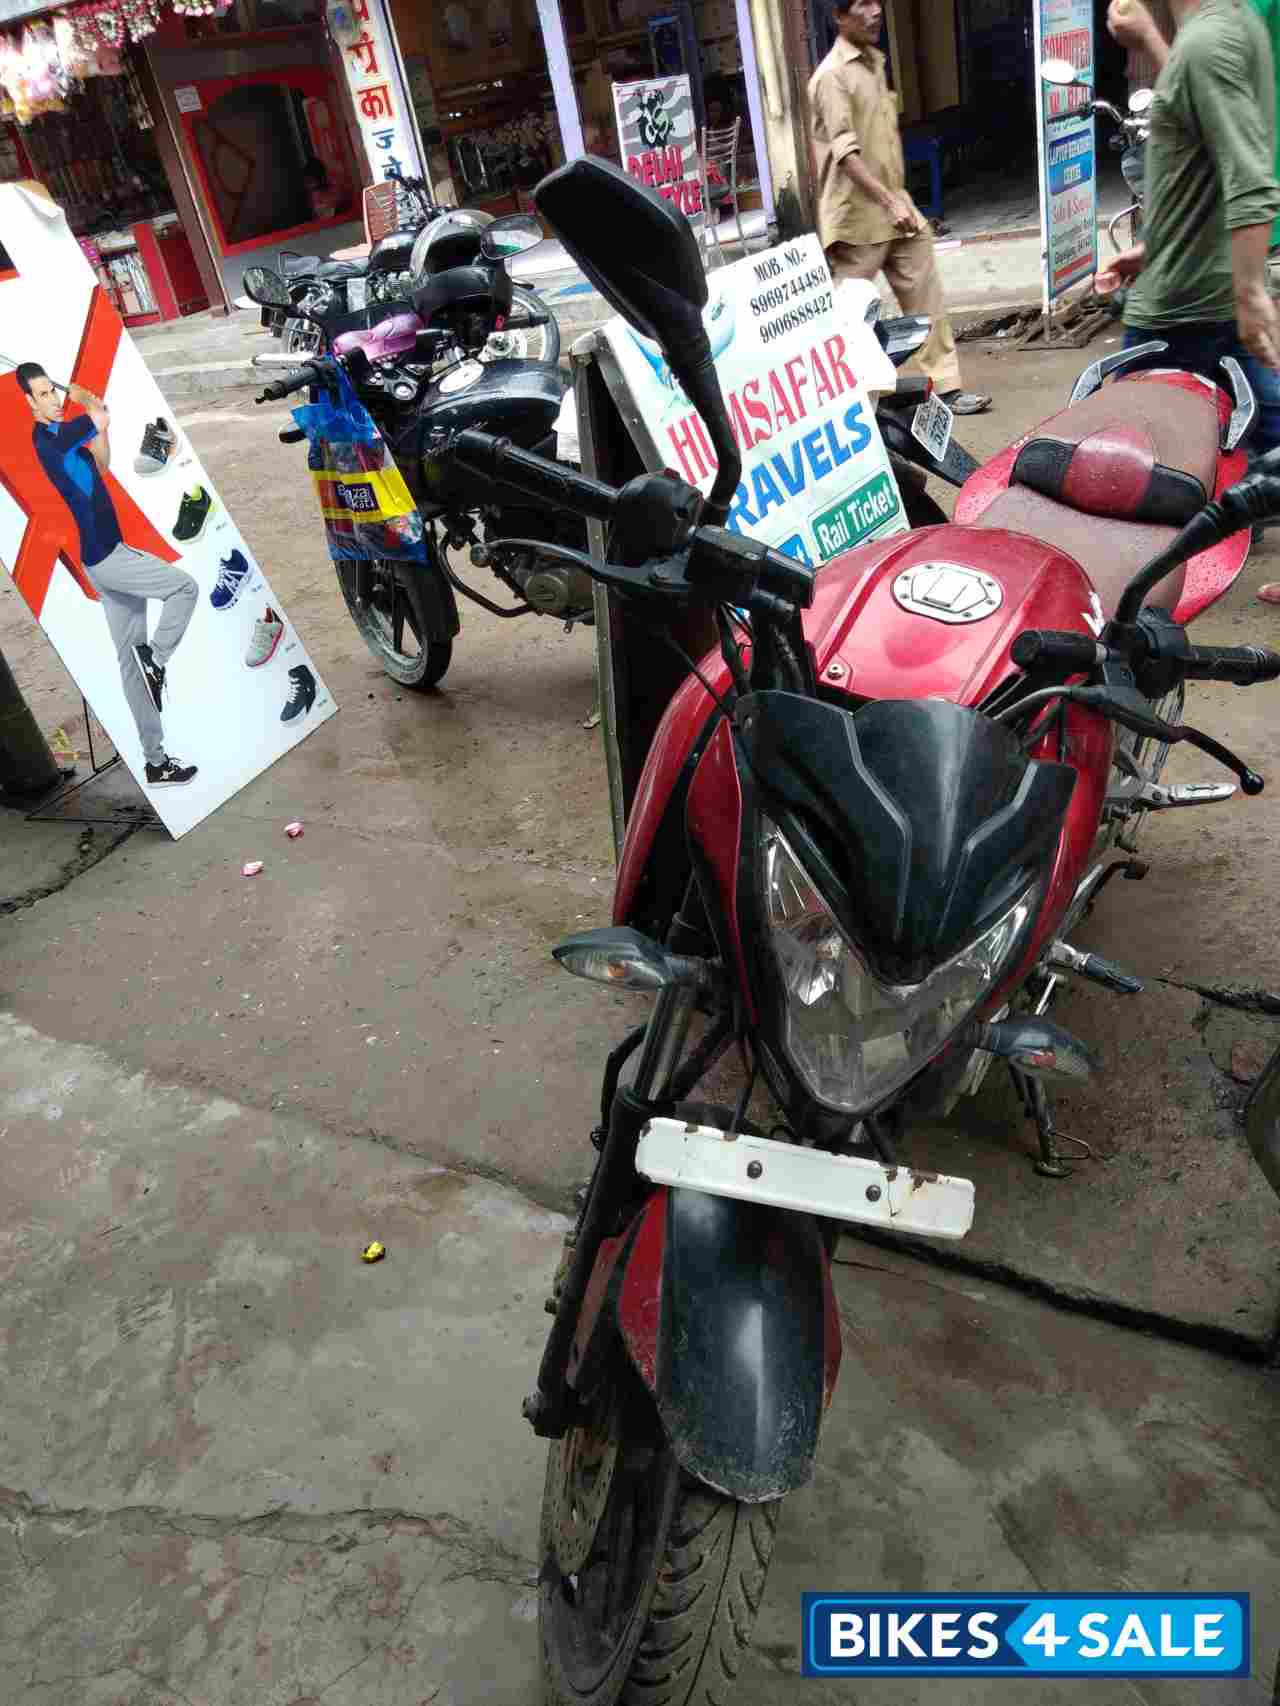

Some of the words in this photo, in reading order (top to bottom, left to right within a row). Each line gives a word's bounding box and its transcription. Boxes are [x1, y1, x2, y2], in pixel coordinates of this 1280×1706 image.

[656, 179, 705, 216] TYLE
[750, 265, 827, 317] 8969744483
[753, 257, 784, 281] MOB.
[759, 291, 833, 343] 9006888427
[724, 401, 872, 536] RAVELS
[817, 509, 850, 556] Rail
[847, 480, 895, 533] Ticket
